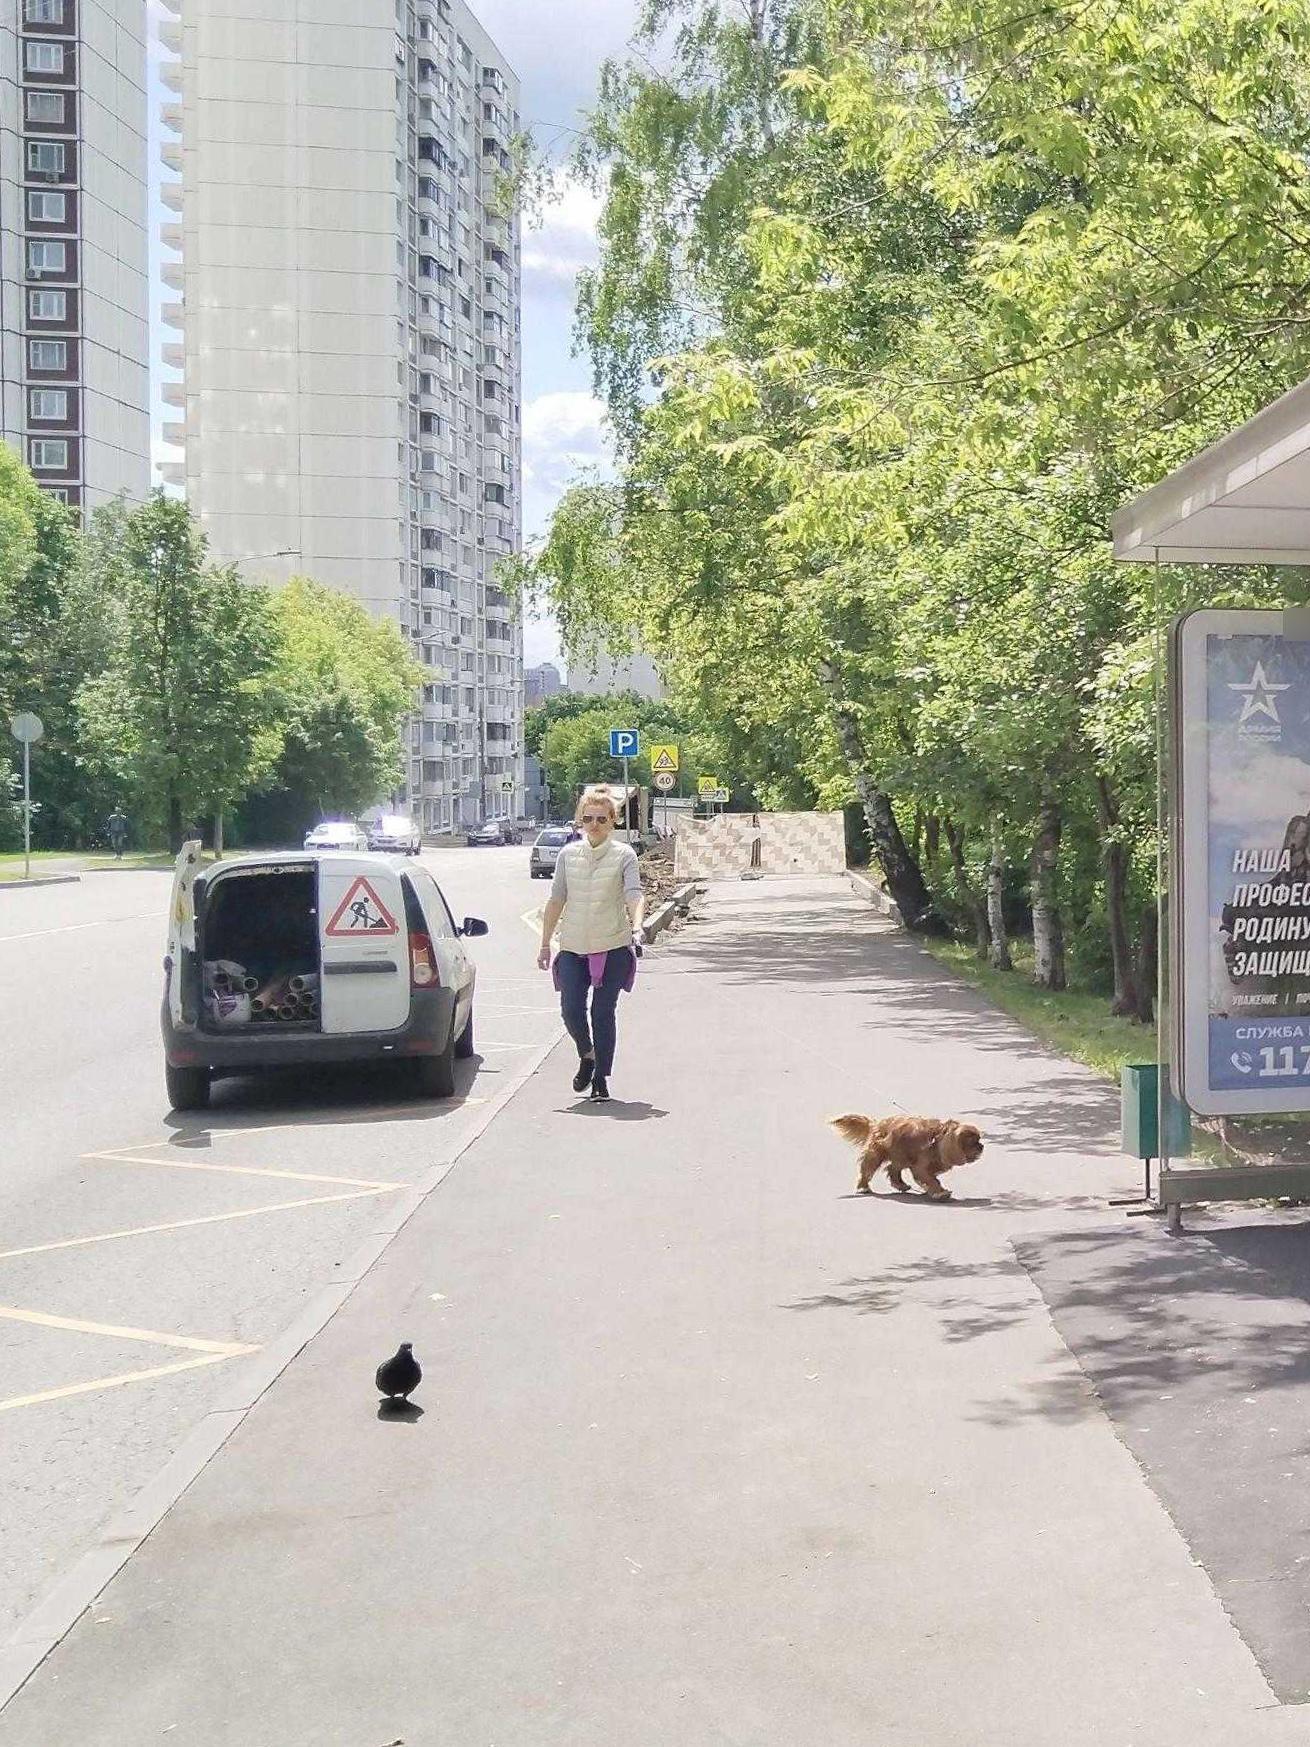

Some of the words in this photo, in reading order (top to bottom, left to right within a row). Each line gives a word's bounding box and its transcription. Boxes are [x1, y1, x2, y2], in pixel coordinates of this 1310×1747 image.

[618, 732, 634, 754] P
[660, 776, 671, 785] 40
[1232, 849, 1291, 873] НАША
[1235, 1025, 1304, 1039] СЛУЖБА
